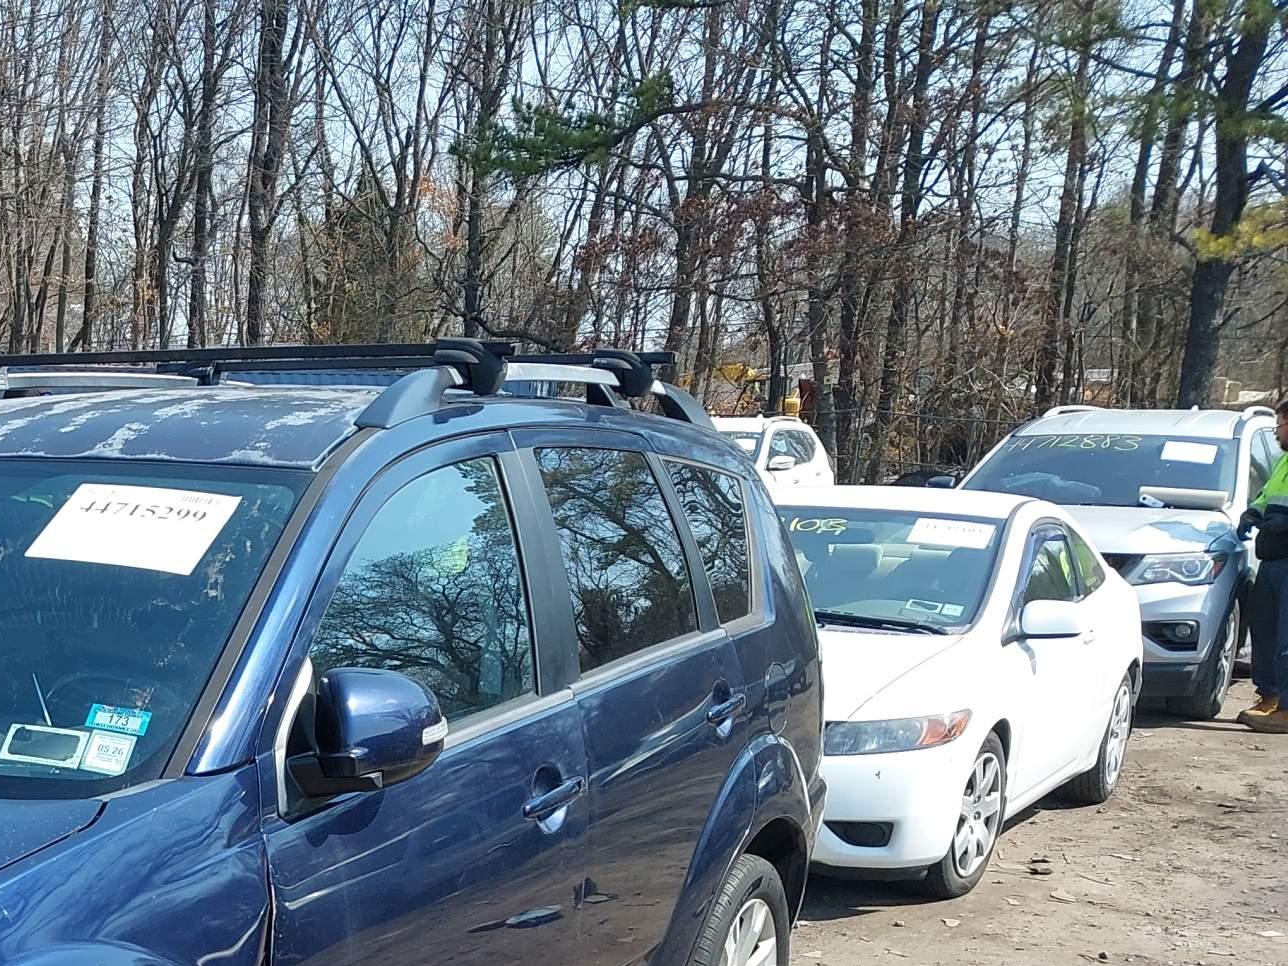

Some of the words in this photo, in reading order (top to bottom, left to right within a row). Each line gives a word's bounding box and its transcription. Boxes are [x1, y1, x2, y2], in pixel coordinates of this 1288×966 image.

[79, 500, 208, 522] 44715299
[108, 714, 130, 727] 173
[97, 743, 110, 753] 05
